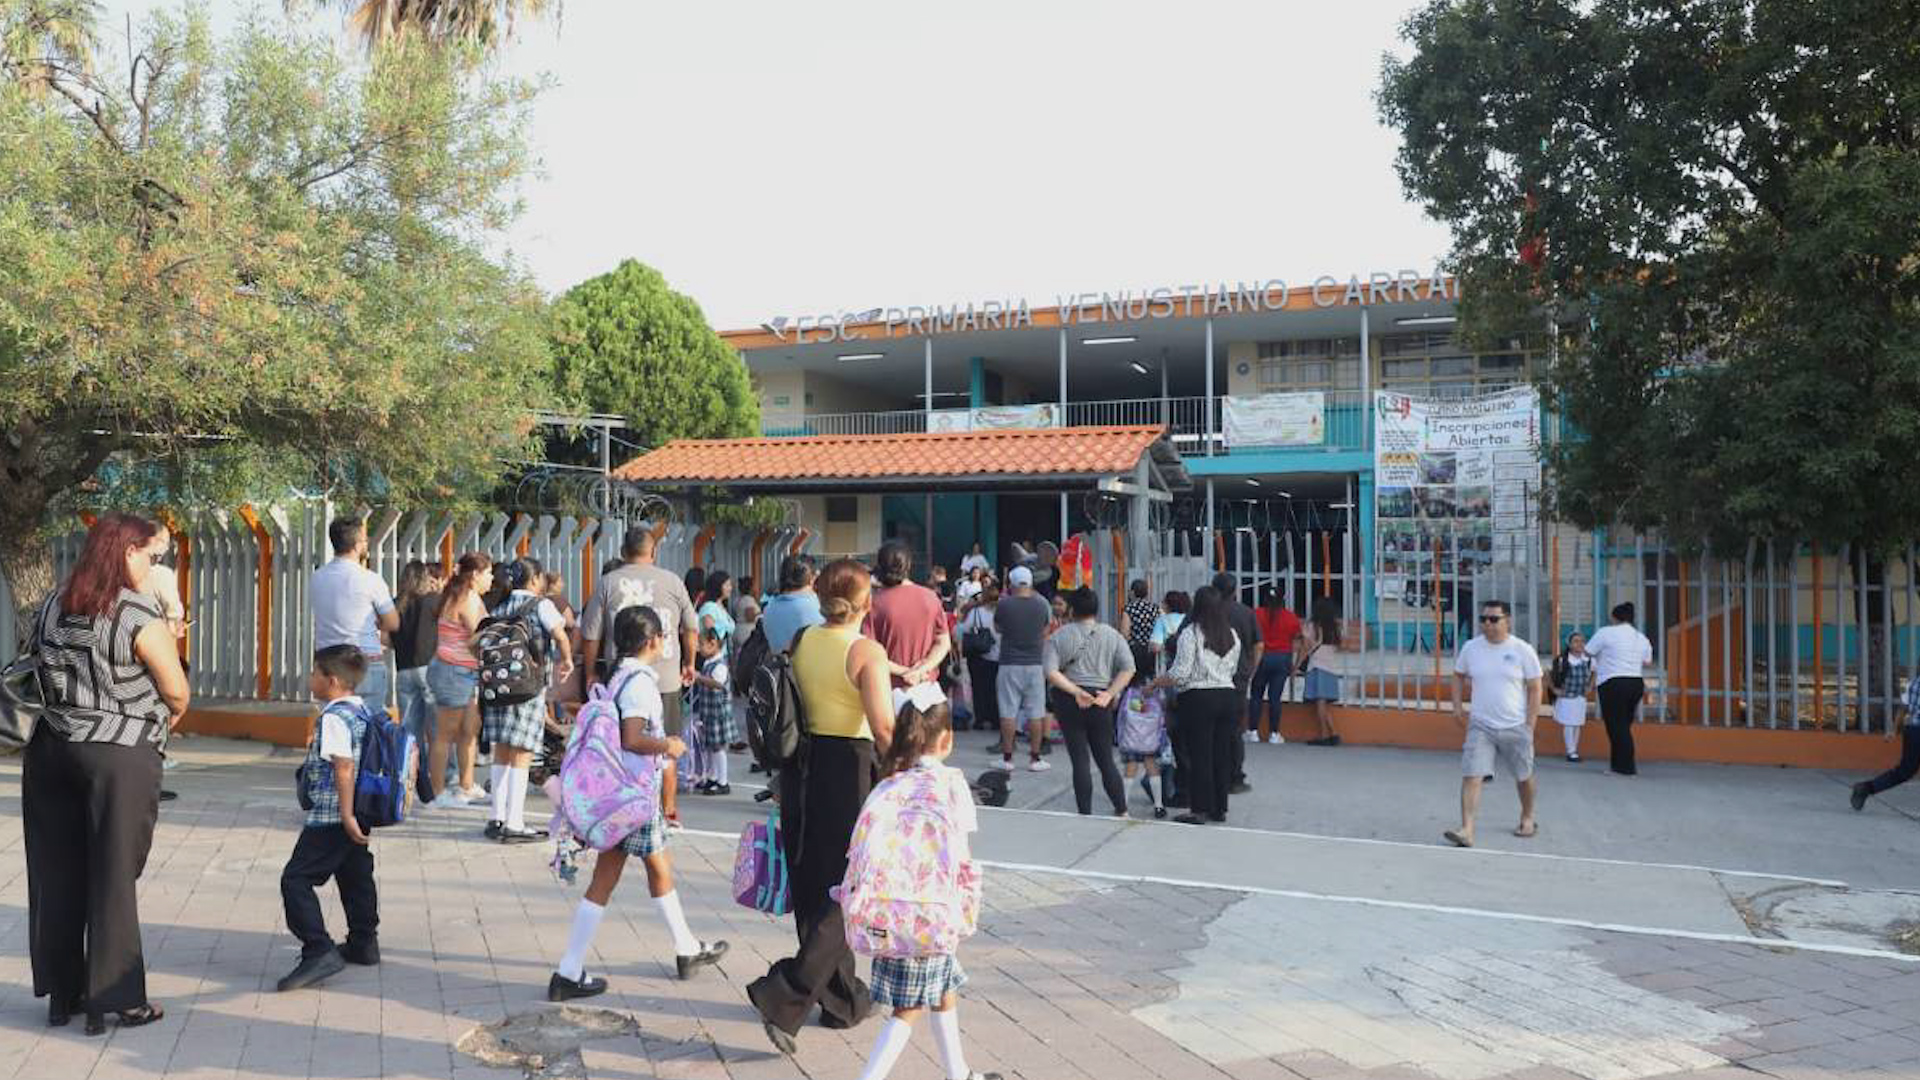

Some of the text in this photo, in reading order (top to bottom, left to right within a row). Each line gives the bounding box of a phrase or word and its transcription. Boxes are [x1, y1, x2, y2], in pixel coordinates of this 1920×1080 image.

[796, 313, 869, 344] ESC.
[886, 298, 1033, 337] PRIMARIA
[1057, 279, 1288, 323] VENUSTIANO
[1432, 419, 1528, 434] Inscripciones
